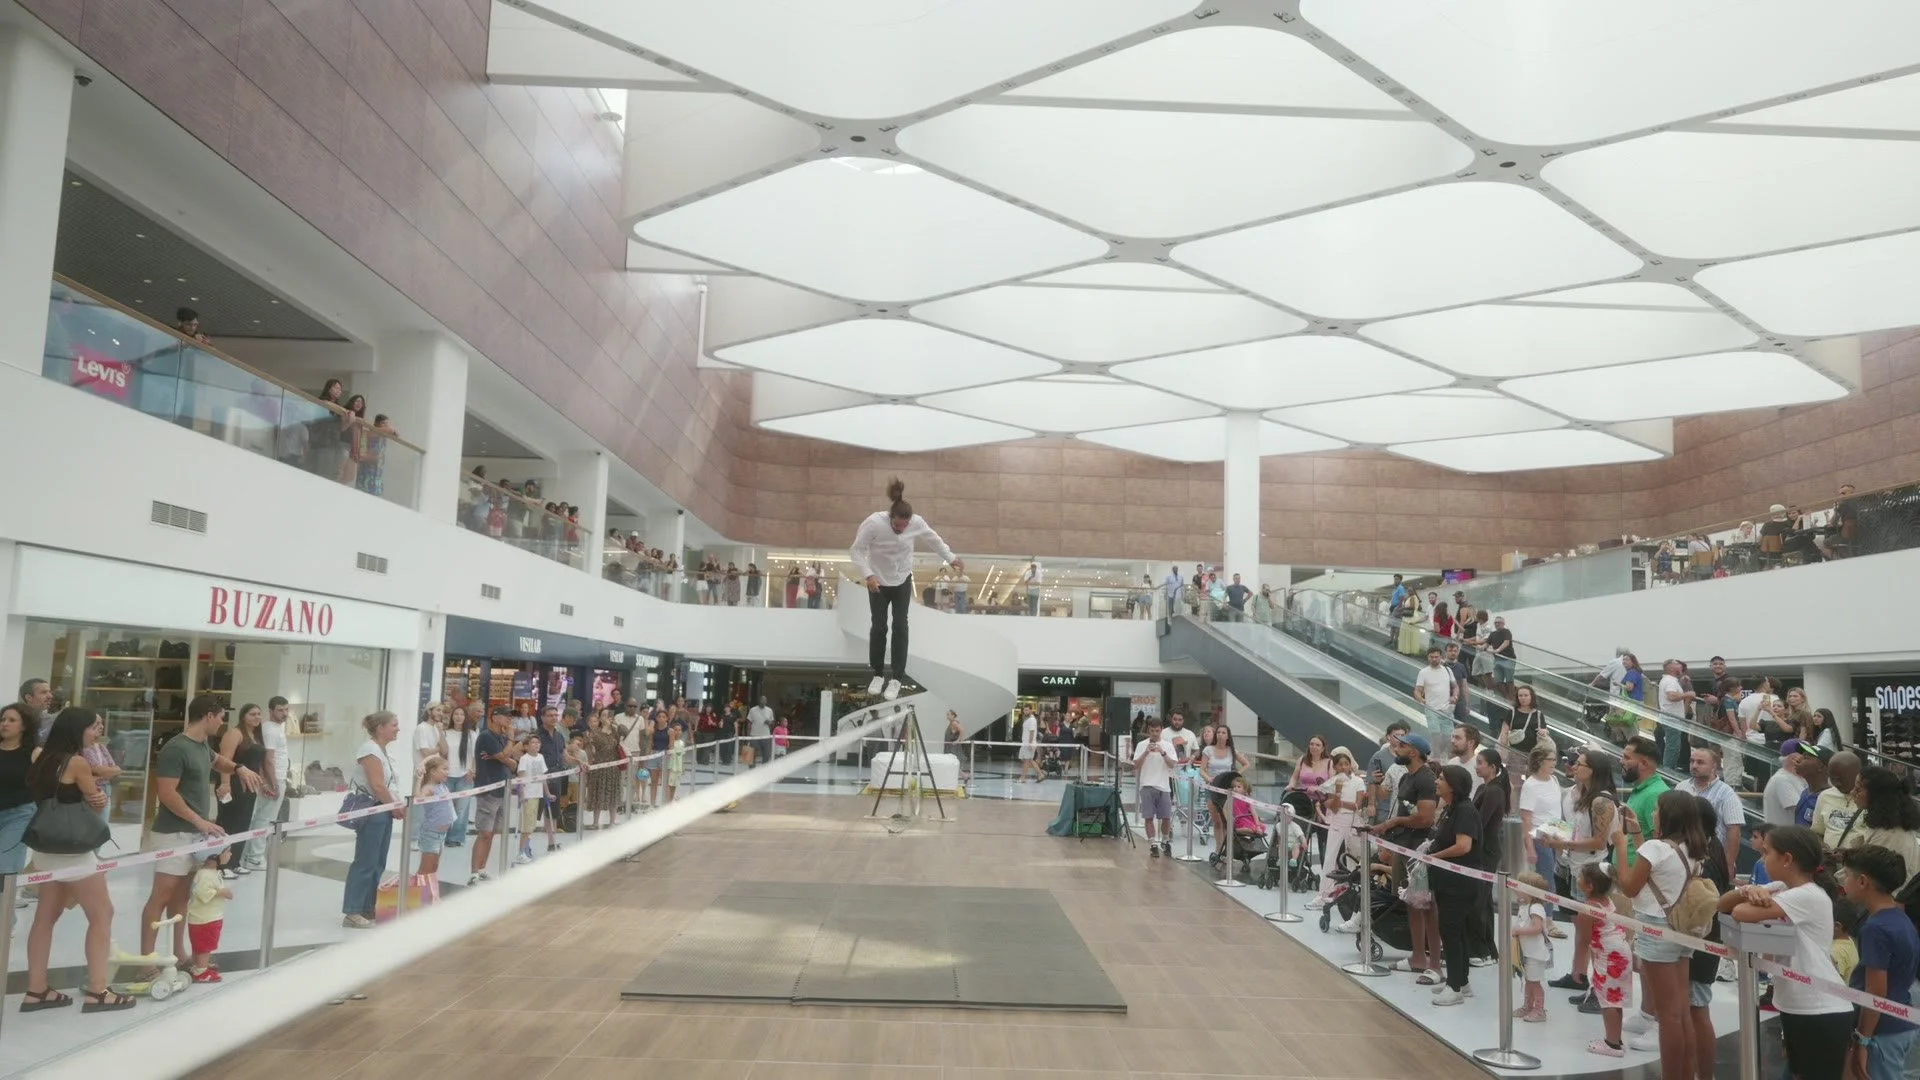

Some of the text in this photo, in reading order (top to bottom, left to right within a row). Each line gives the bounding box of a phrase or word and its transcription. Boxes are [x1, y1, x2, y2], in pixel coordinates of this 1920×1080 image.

[1042, 676, 1077, 685] CARAT
[1782, 968, 1812, 985] balexert
[1872, 997, 1909, 1018] balexert
